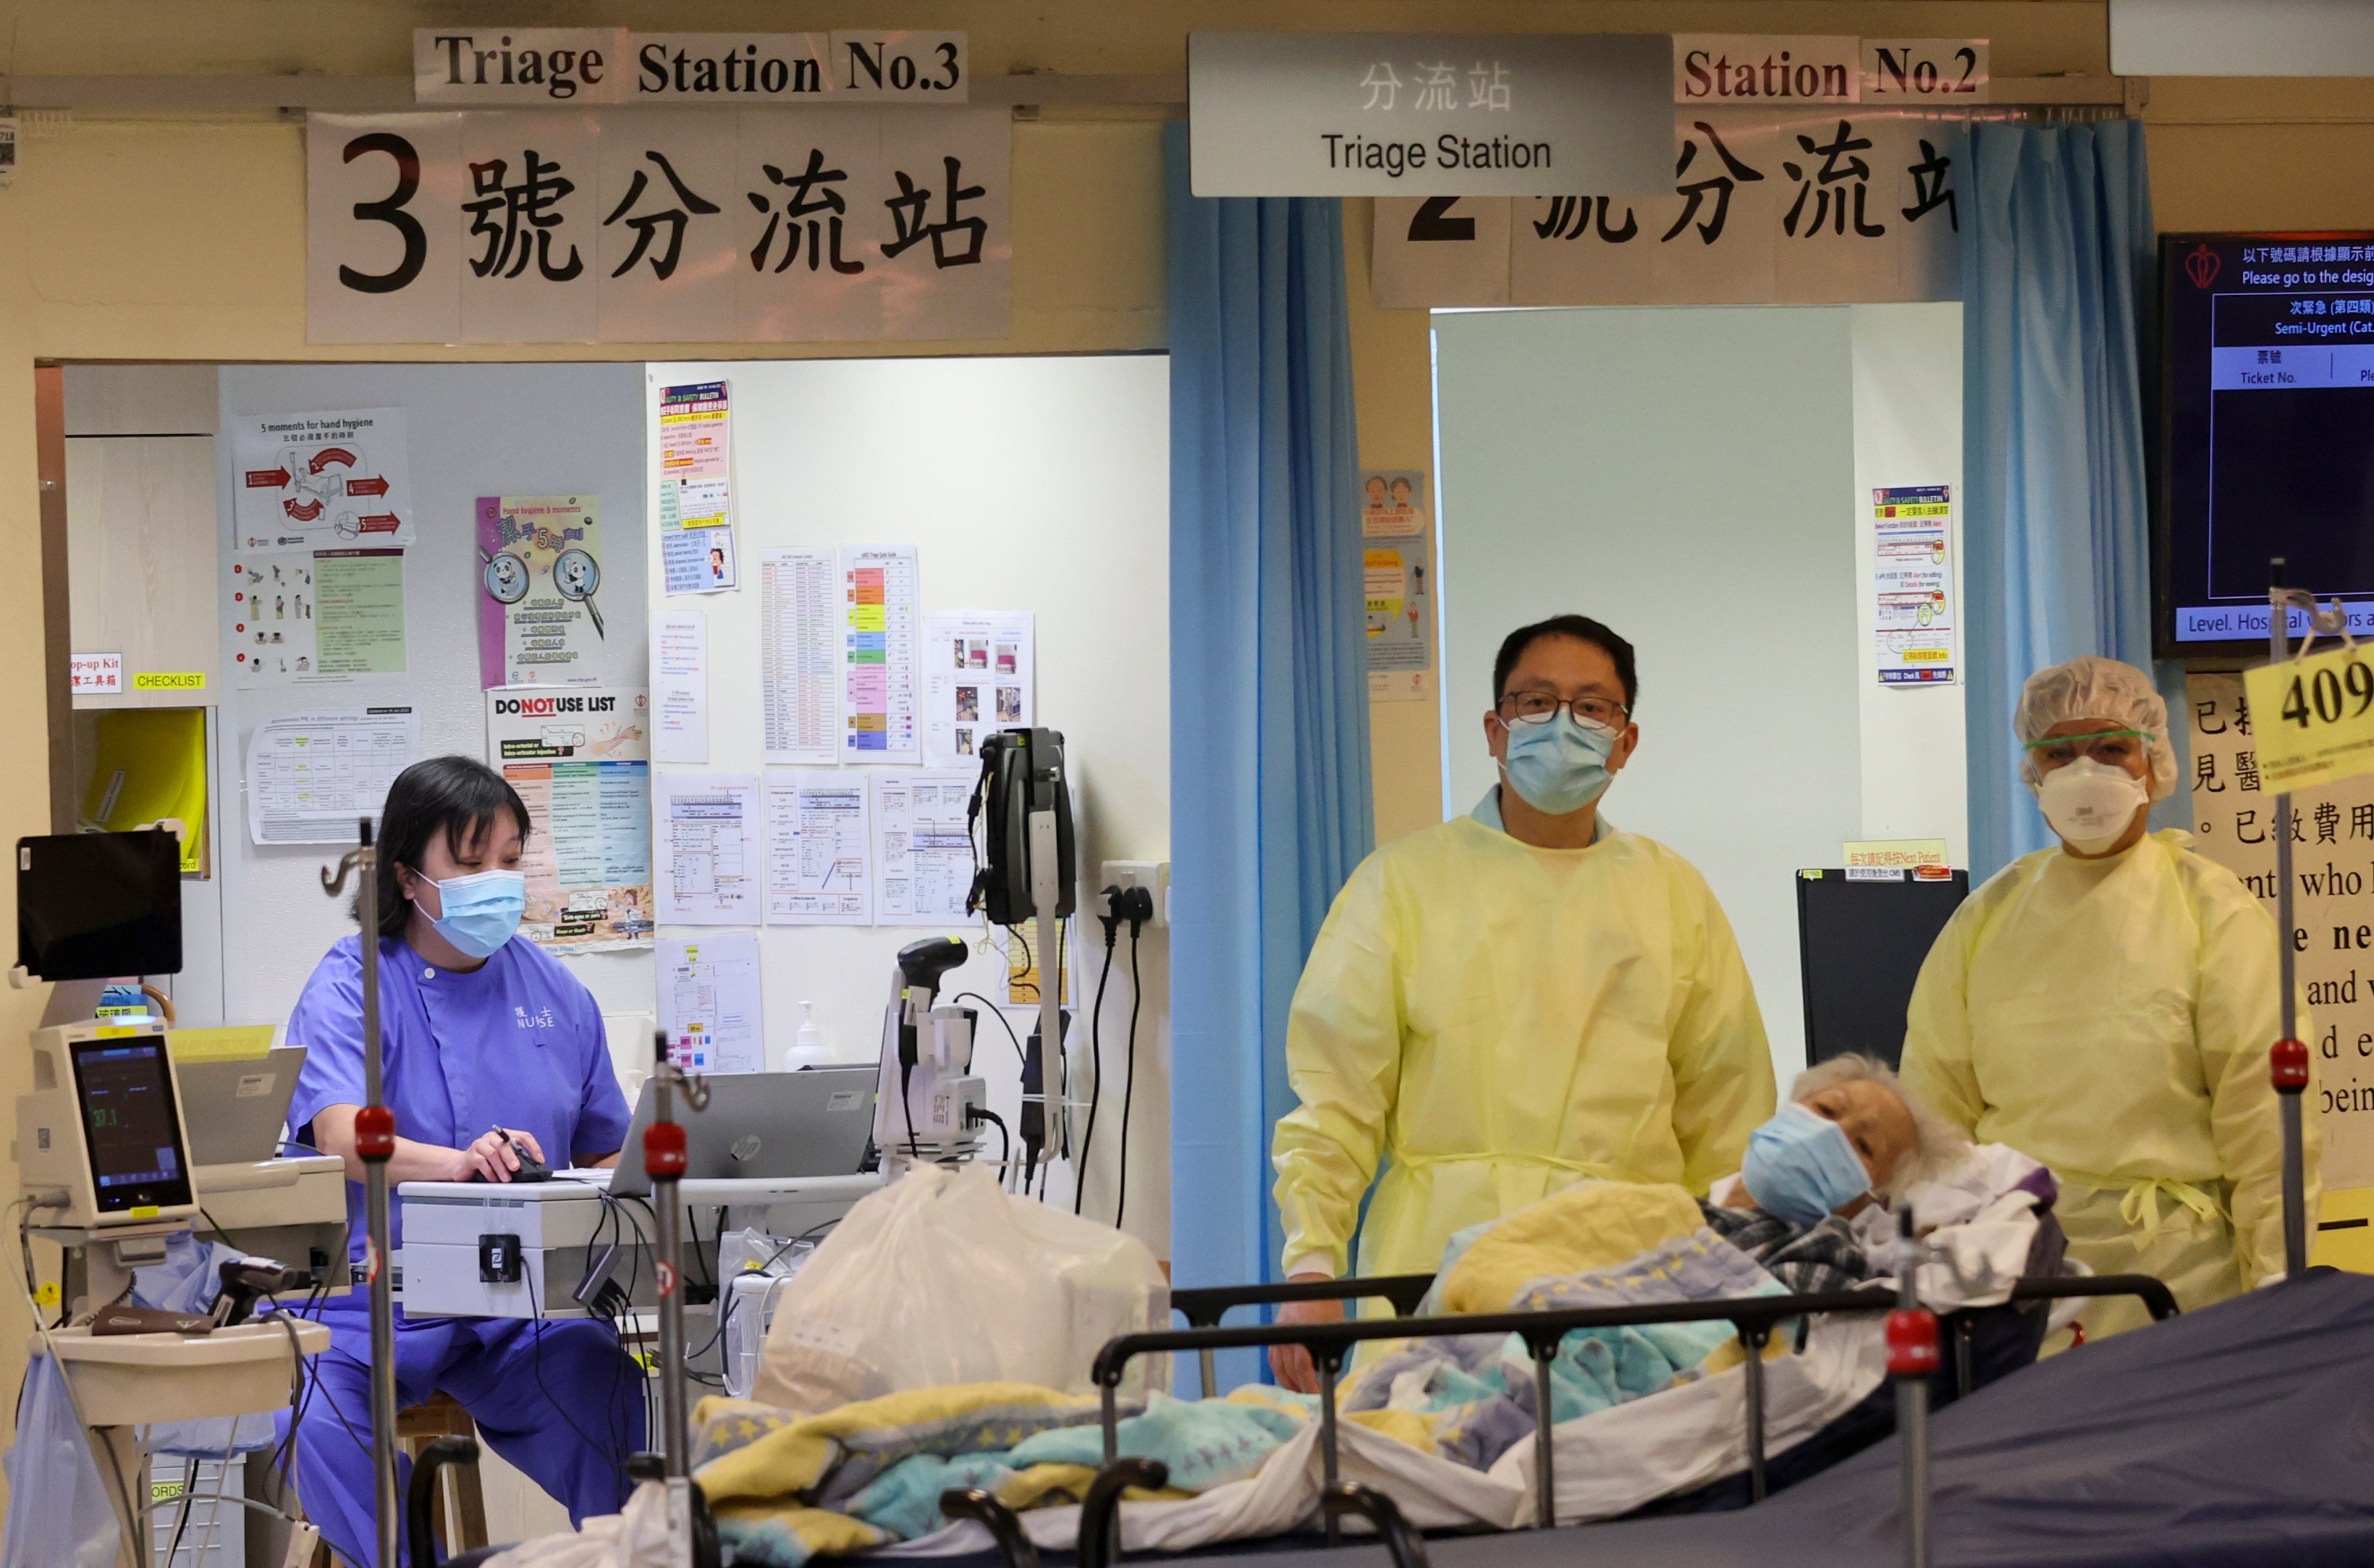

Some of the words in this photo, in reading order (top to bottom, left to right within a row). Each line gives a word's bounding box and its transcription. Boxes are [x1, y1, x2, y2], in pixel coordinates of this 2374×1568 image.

[435, 36, 604, 98] Triage
[638, 43, 821, 94] Station
[845, 41, 960, 90] No.3
[1684, 49, 1849, 100] Station
[1873, 45, 1978, 96] No.2
[1359, 61, 1512, 112] 分流站
[1322, 133, 1426, 179] Triage
[1436, 133, 1552, 170] Station
[2242, 271, 2280, 284] Please
[2284, 274, 2300, 288] go
[2303, 271, 2315, 284] to
[2319, 269, 2339, 283] the
[2290, 300, 2326, 315] 次緊急
[2275, 322, 2347, 337] Semi-Urgent
[2257, 350, 2281, 364] 票號
[2241, 372, 2274, 384] Ticket
[2278, 372, 2297, 384] No.
[262, 424, 266, 433] 5
[268, 422, 305, 433] moments
[307, 420, 318, 430] for
[321, 419, 340, 430] hand
[343, 418, 373, 430] hygiene
[2189, 614, 2232, 632] Level.
[103, 658, 118, 669] Kit
[137, 676, 202, 687] CHECKLIST
[2281, 661, 2374, 728] 409
[496, 699, 520, 714] DO
[522, 698, 554, 713] NOT
[557, 698, 583, 712] USE
[589, 696, 615, 712] LIST
[1918, 851, 1941, 863] Patient
[2299, 862, 2362, 897] who
[2307, 969, 2358, 1006] and
